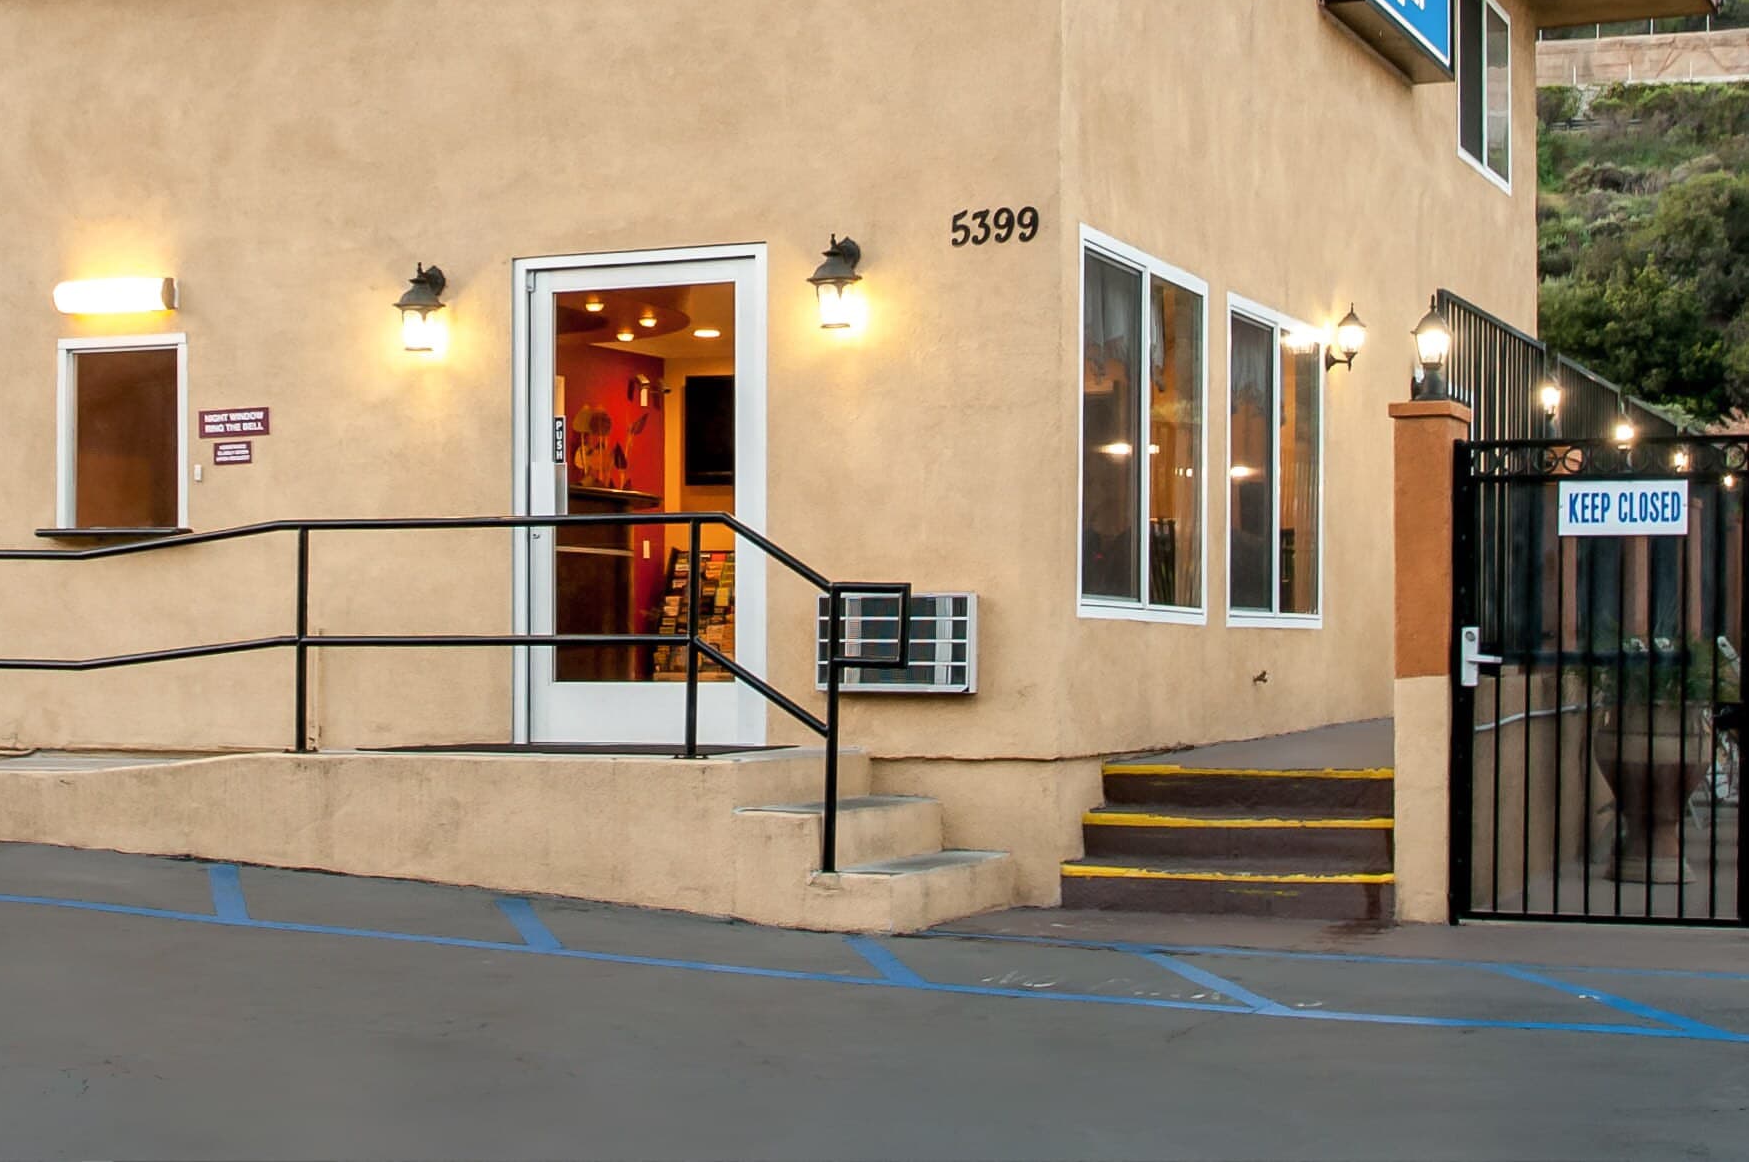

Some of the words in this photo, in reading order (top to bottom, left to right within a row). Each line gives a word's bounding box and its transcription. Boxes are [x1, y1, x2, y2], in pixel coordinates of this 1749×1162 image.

[951, 206, 1040, 247] 5399
[204, 413, 228, 423] NIGHT
[229, 411, 264, 421] WINDOW
[205, 424, 224, 433] RING
[226, 423, 242, 431] THE
[242, 422, 264, 431] BELL
[555, 420, 563, 460] PUSH
[1569, 492, 1611, 524] KEEP
[1618, 491, 1681, 523] CLOSED
